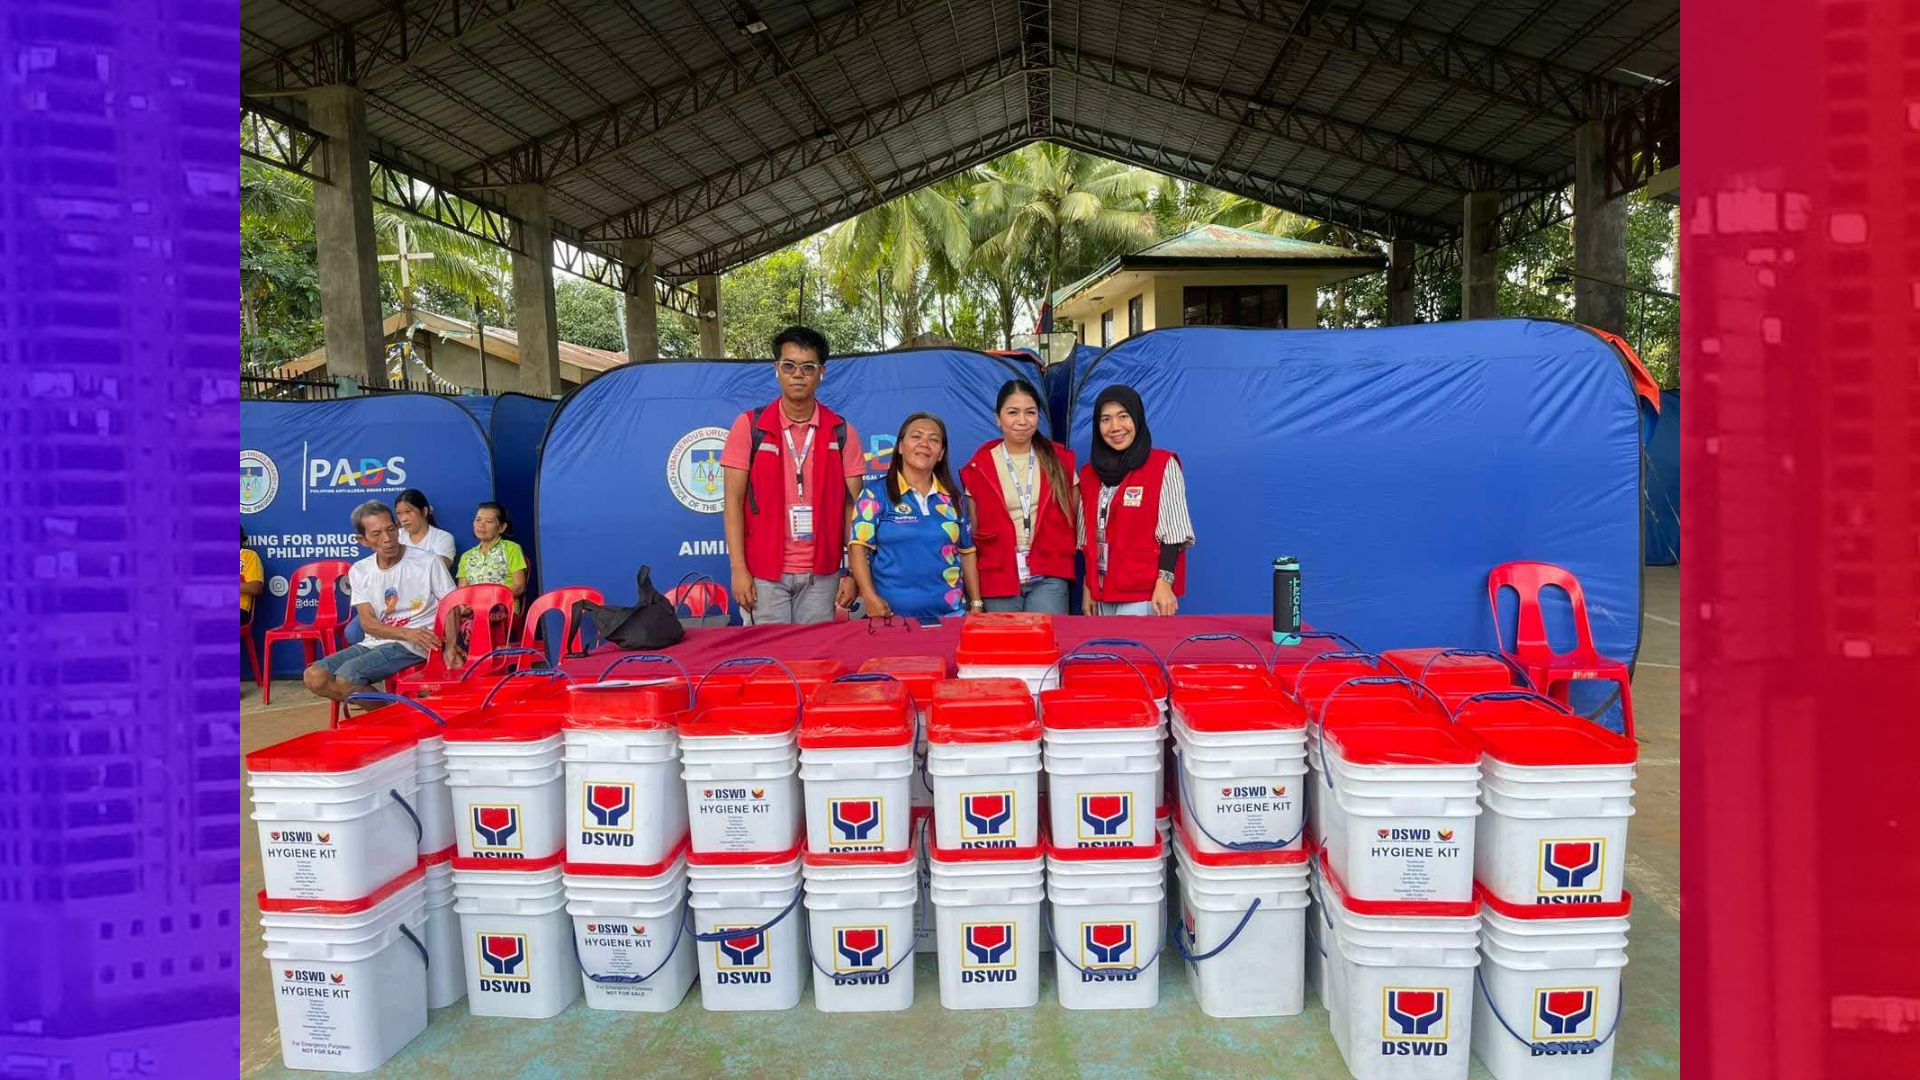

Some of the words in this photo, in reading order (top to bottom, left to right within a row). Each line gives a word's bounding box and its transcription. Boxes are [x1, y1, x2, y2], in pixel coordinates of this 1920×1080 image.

[309, 456, 407, 486] PADS
[688, 500, 700, 508] OF
[702, 503, 718, 512] THE
[283, 534, 312, 546] FOR
[317, 534, 359, 545] DRUG
[267, 546, 360, 558] PHILIPPINES
[679, 540, 730, 556] AIMI
[716, 788, 746, 798] DSWD
[1234, 786, 1267, 798] DSWD
[700, 804, 749, 814] HYGIENE
[752, 804, 770, 813] KIT
[1216, 802, 1270, 814] HYGIENE
[1272, 802, 1292, 811] KIT
[282, 832, 312, 842] DSWD
[582, 832, 634, 847] DSWD
[1392, 828, 1430, 840] DSWD
[268, 848, 316, 858] HYGIENE
[320, 849, 336, 859] KIT
[1372, 847, 1434, 858] HYGIENE
[1438, 848, 1460, 858] KIT
[598, 924, 628, 934] DSWD
[584, 938, 632, 948] HYGIENE
[635, 939, 652, 948] KIT
[295, 970, 326, 982] DSWD
[717, 972, 772, 984] DSWD
[834, 972, 890, 986] DSWD
[962, 969, 1017, 983] DSWD
[480, 979, 532, 994] DSWD
[282, 986, 330, 998] HYGIENE
[333, 989, 351, 1000] KIT
[1382, 1041, 1448, 1056] DSWD
